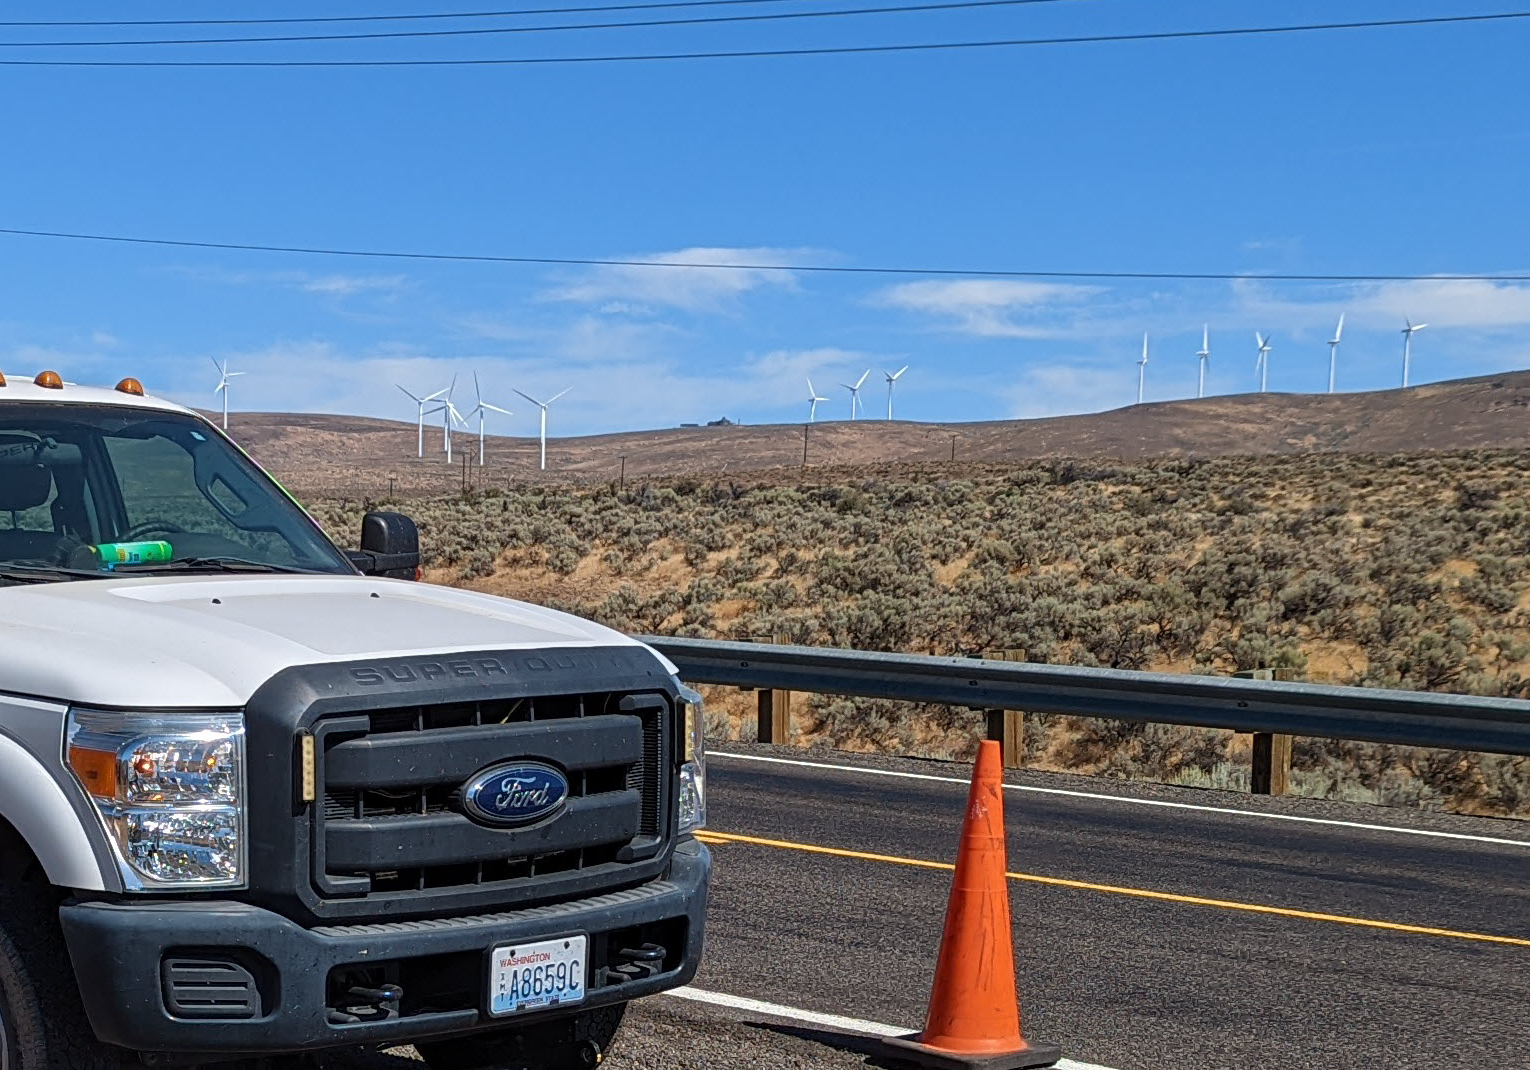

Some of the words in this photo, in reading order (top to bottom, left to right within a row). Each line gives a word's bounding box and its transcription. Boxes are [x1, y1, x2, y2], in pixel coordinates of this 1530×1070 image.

[349, 656, 509, 687] SUPER
[495, 776, 551, 811] Ford
[499, 952, 551, 968] WASHINGTON
[509, 959, 580, 1001] A8659C
